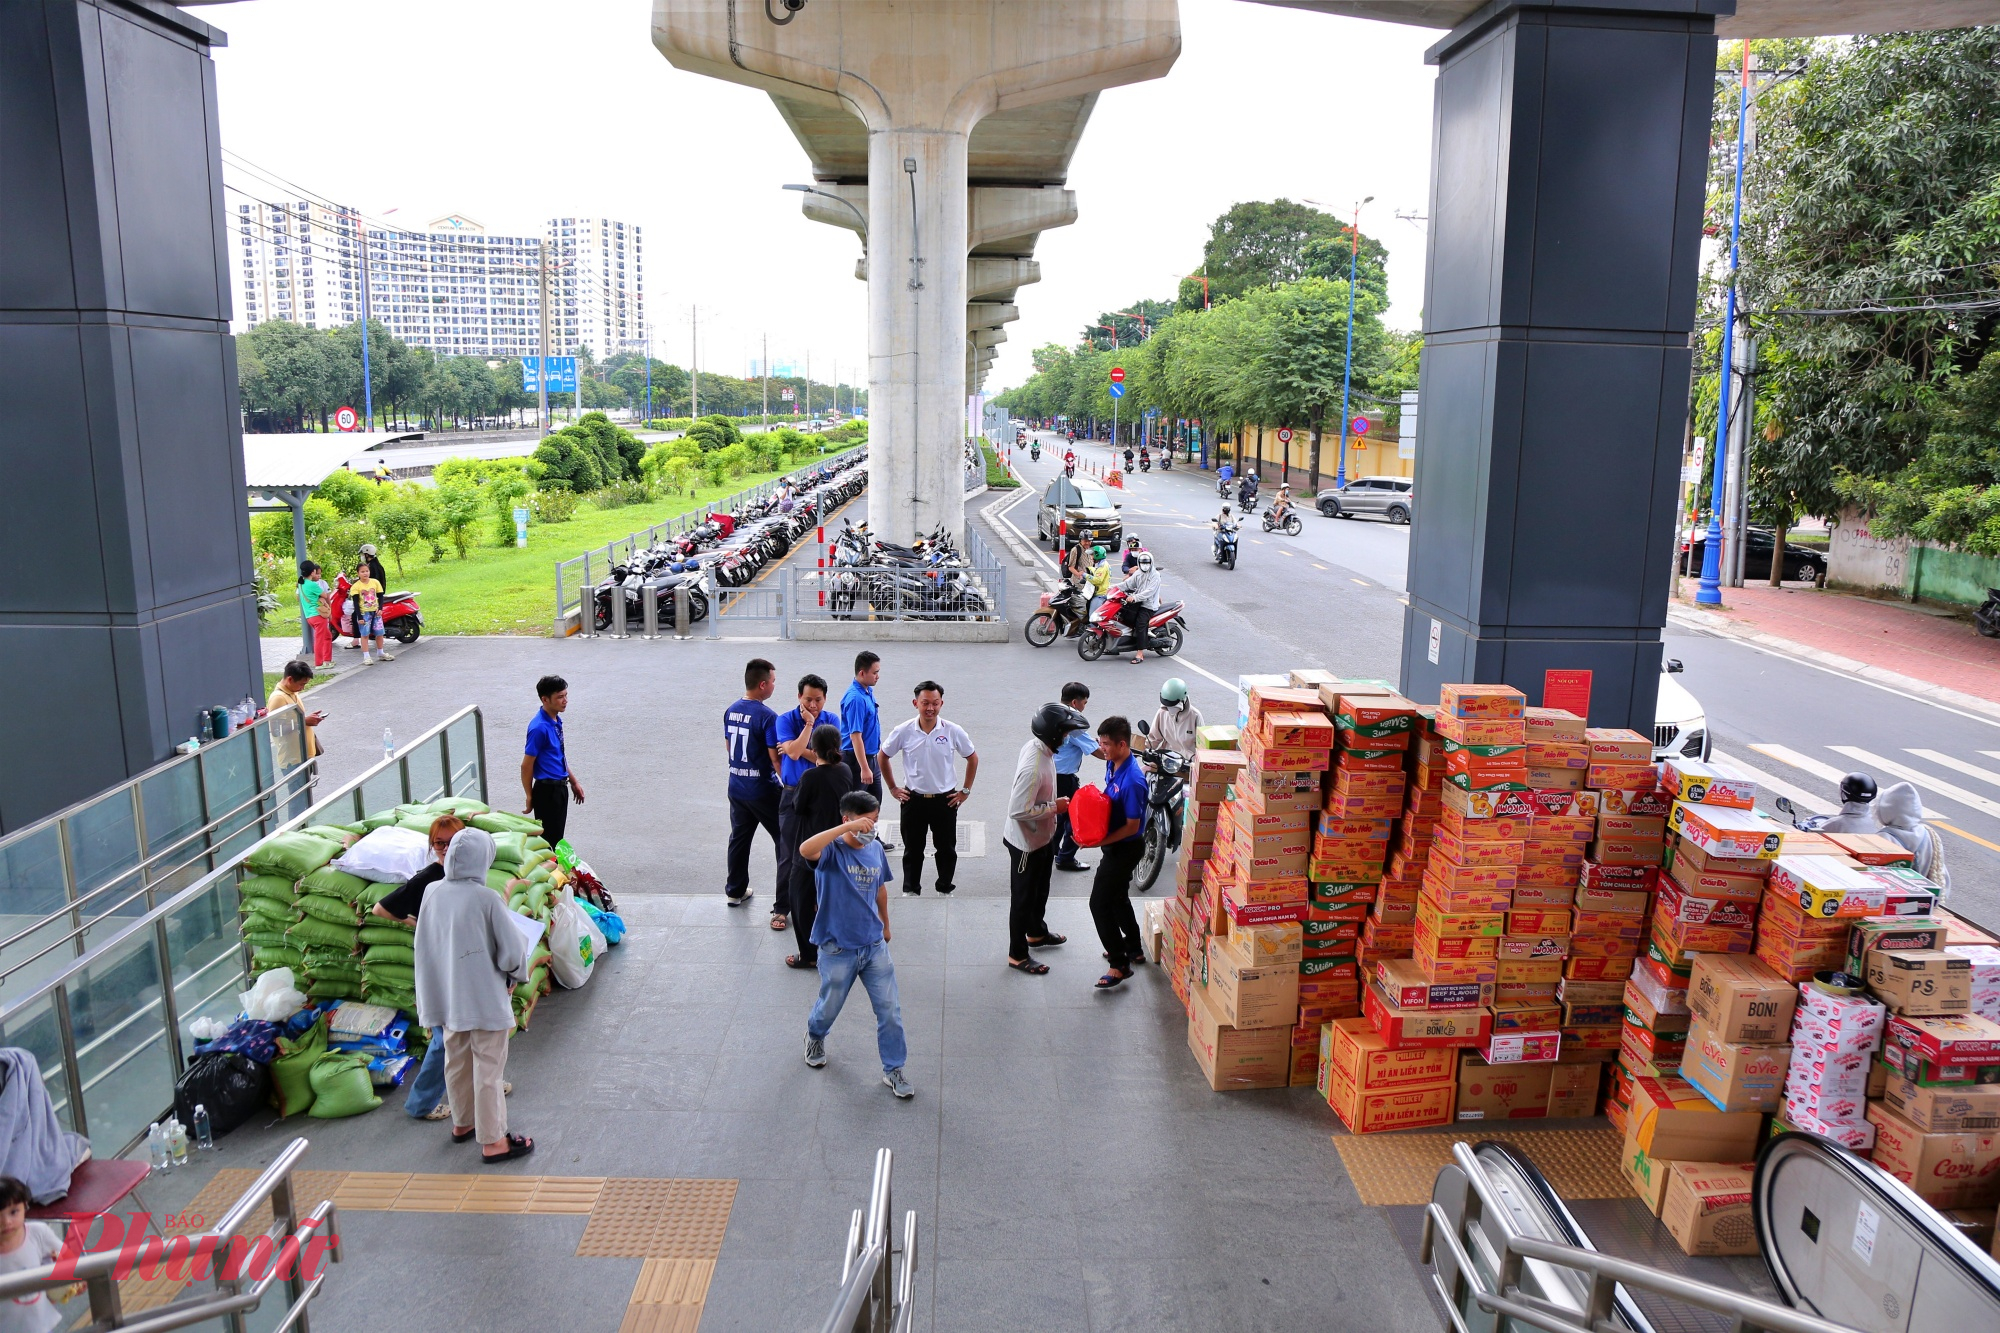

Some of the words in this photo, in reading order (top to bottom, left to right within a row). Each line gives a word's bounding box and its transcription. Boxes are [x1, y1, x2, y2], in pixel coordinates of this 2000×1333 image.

[341, 413, 351, 424] 60
[1281, 431, 1289, 439] 50
[727, 725, 750, 763] 77
[1530, 771, 1551, 779] Select
[1536, 794, 1572, 804] KOKOMI
[1497, 804, 1532, 814] KOKOMI
[1549, 804, 1561, 812] 90
[1631, 803, 1669, 814] KOKOMI
[1600, 866, 1632, 876] KOKOMI
[1289, 912, 1298, 920] BỘ
[1711, 912, 1751, 923] KOKOMI
[1881, 938, 1923, 949] Omachi
[1532, 946, 1564, 954] KOKOMI
[1699, 977, 1714, 999] BON!
[1748, 1002, 1778, 1017] BON!
[1426, 1026, 1444, 1035] BON!
